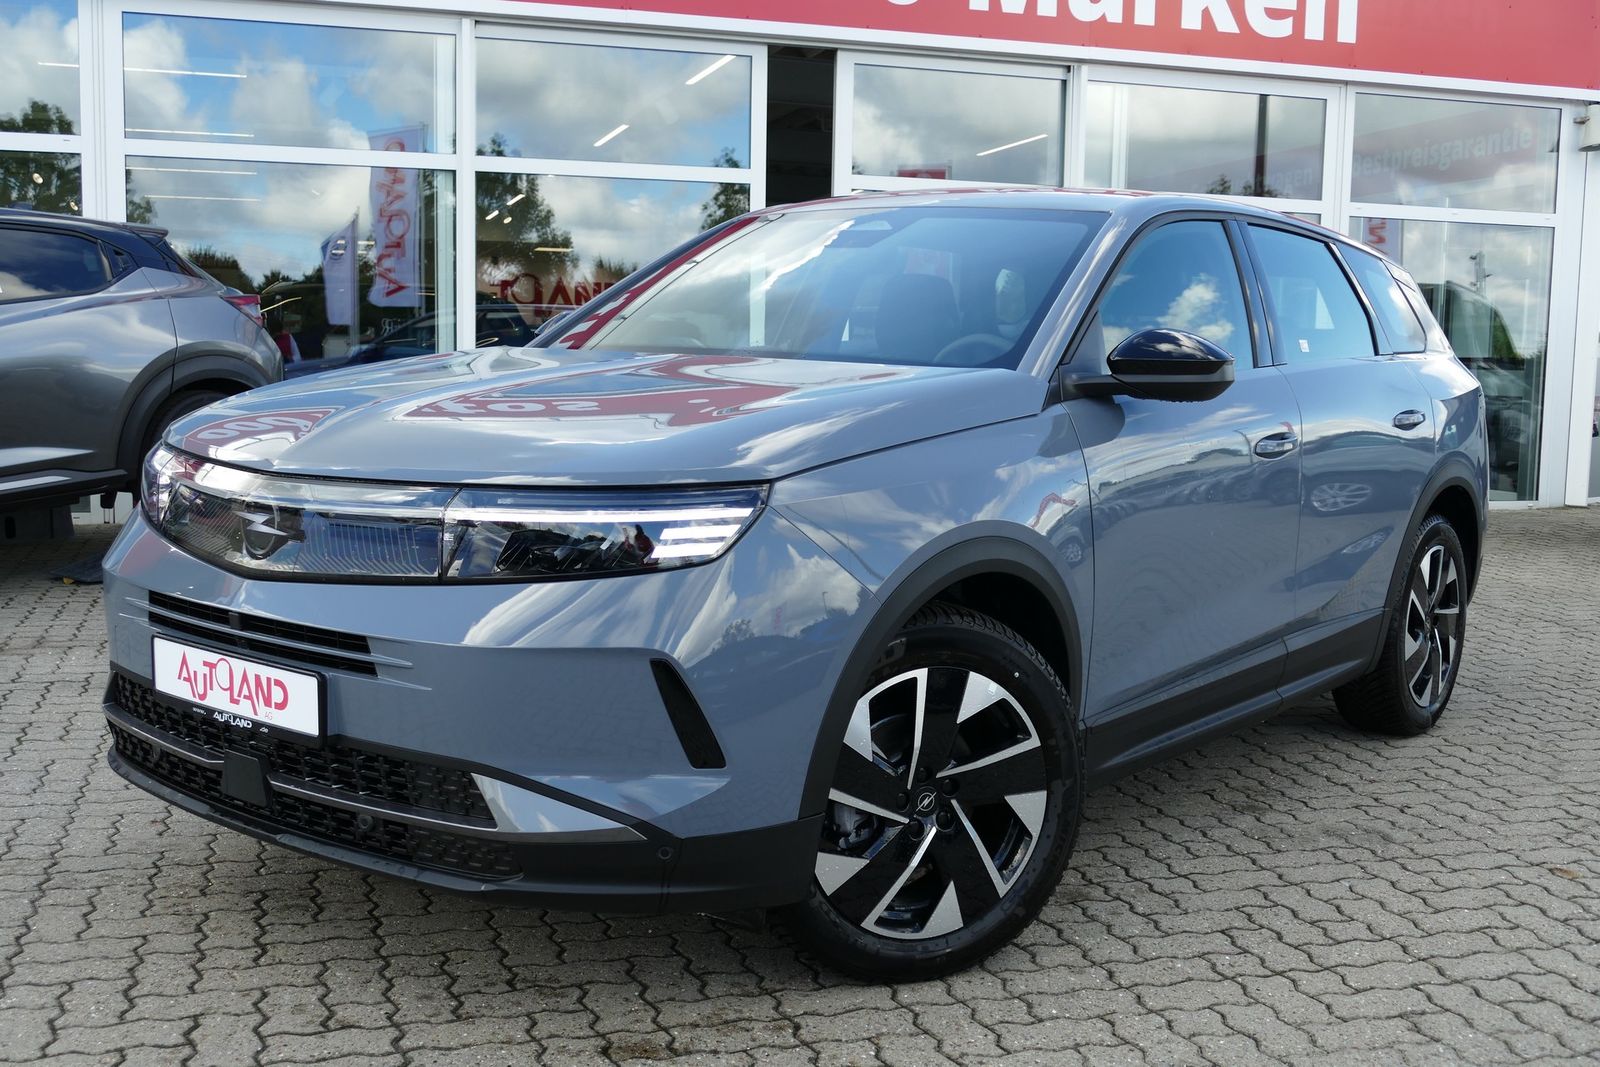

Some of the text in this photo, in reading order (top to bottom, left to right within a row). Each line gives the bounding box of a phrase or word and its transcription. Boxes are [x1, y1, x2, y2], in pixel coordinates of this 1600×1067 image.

[969, 0, 1357, 44] ken
[178, 650, 289, 716] AUTOLAND
[213, 711, 252, 728] AUTOLAND
